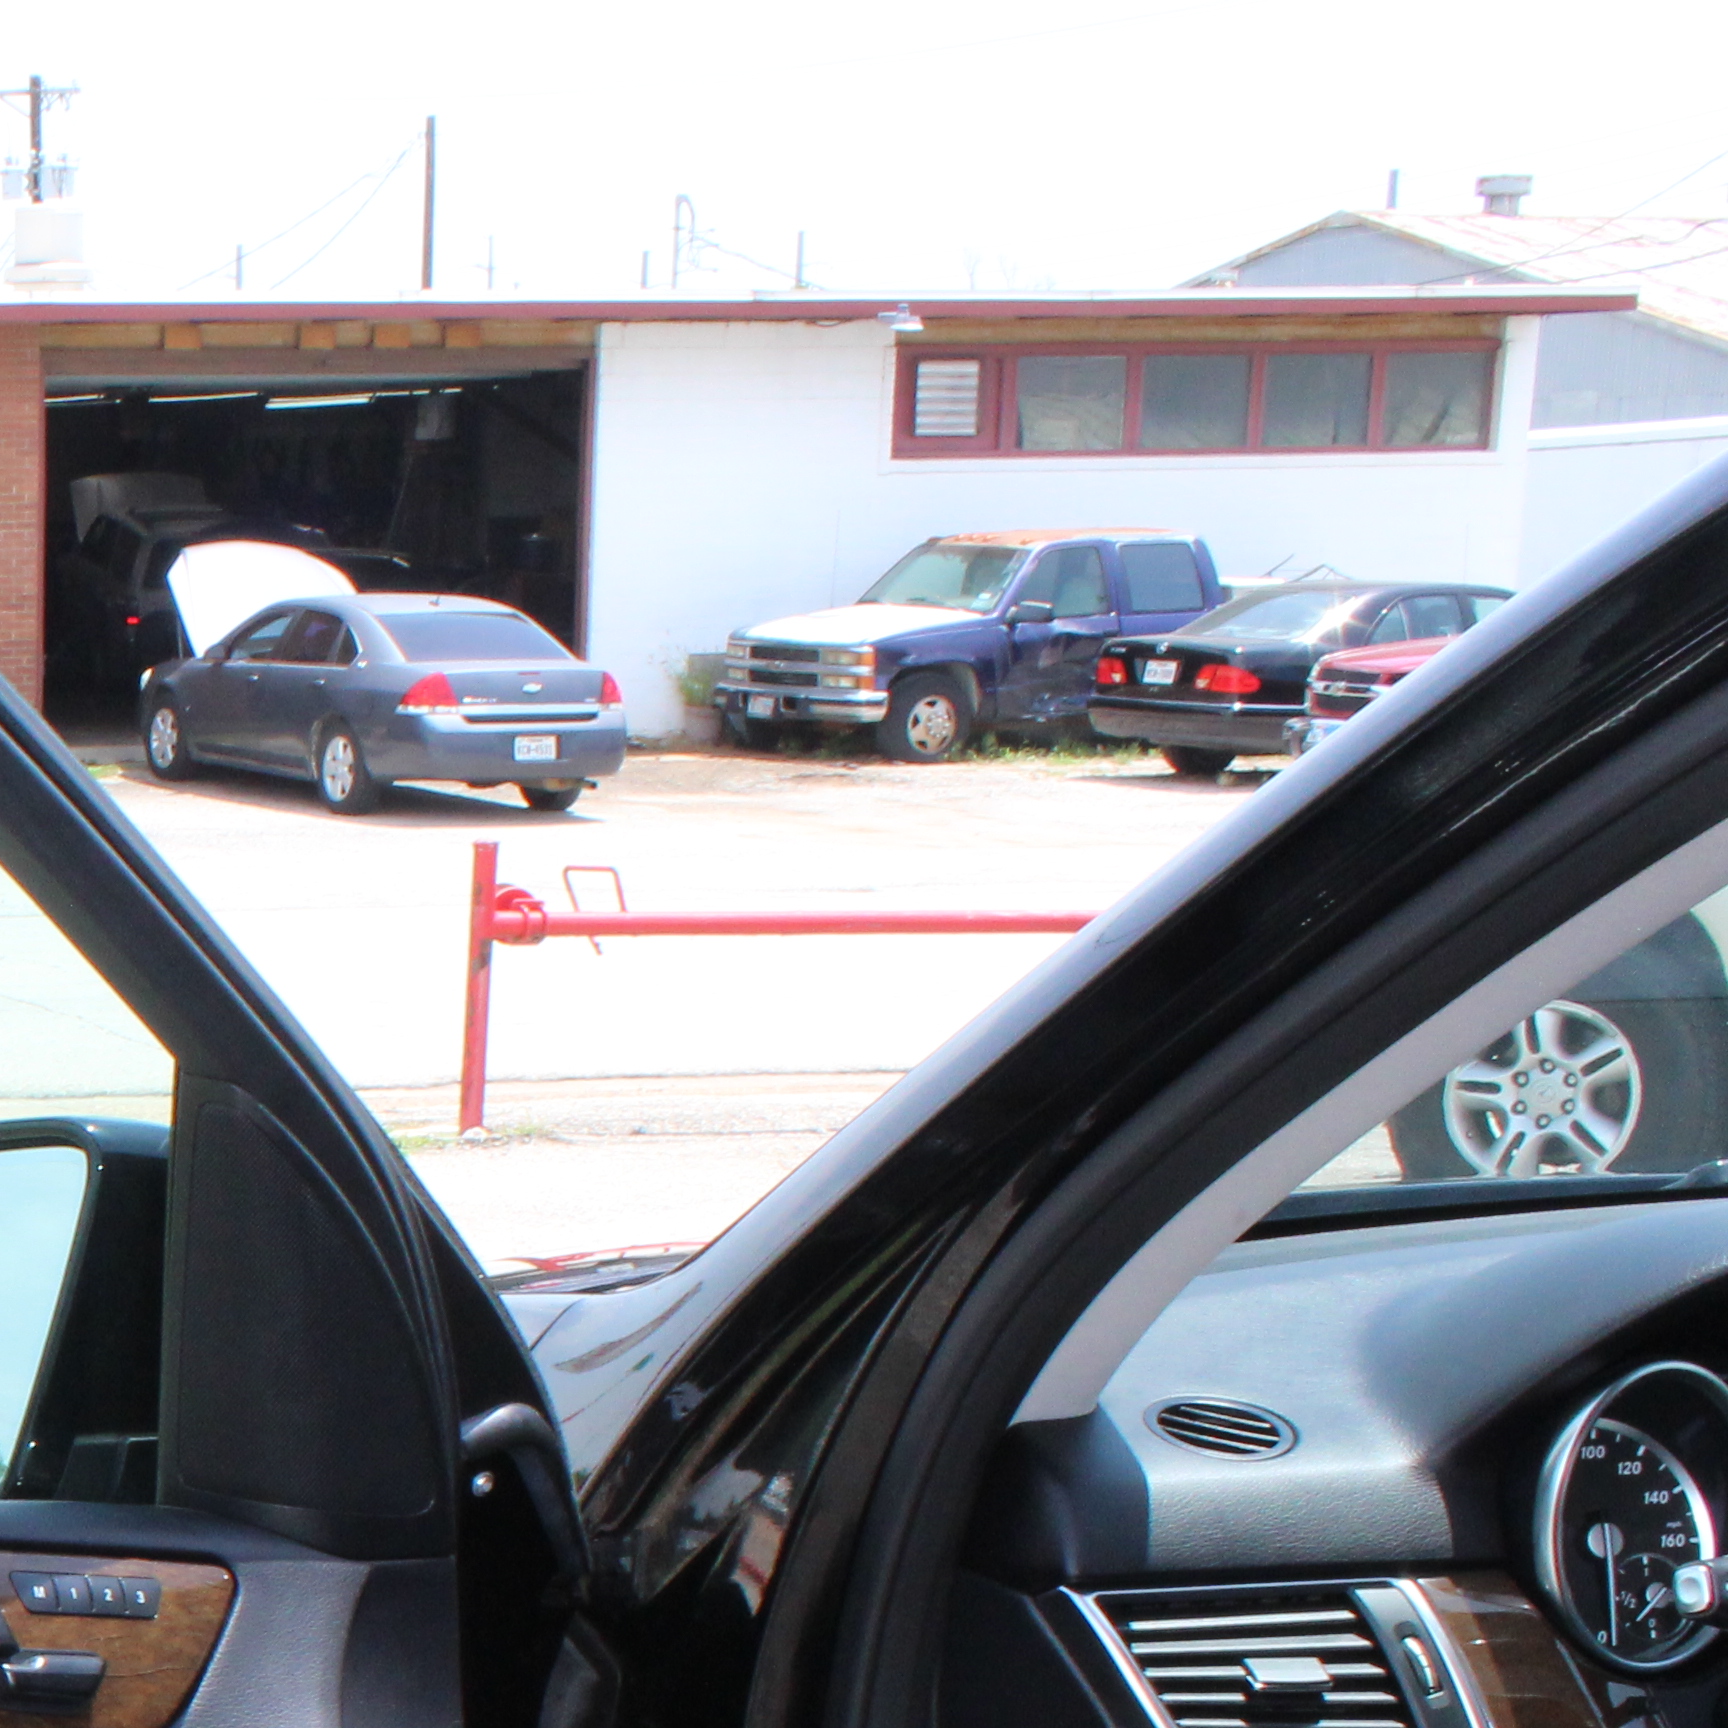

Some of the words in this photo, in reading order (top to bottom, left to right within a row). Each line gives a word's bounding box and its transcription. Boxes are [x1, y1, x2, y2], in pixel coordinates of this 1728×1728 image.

[1581, 1446, 1605, 1459] 100
[1618, 1462, 1642, 1475] 120
[1644, 1491, 1669, 1504] 140
[1660, 1533, 1685, 1548] 160
[32, 1586, 46, 1599] M
[70, 1588, 77, 1600] 1
[104, 1589, 113, 1602] 2
[136, 1591, 146, 1604] 3
